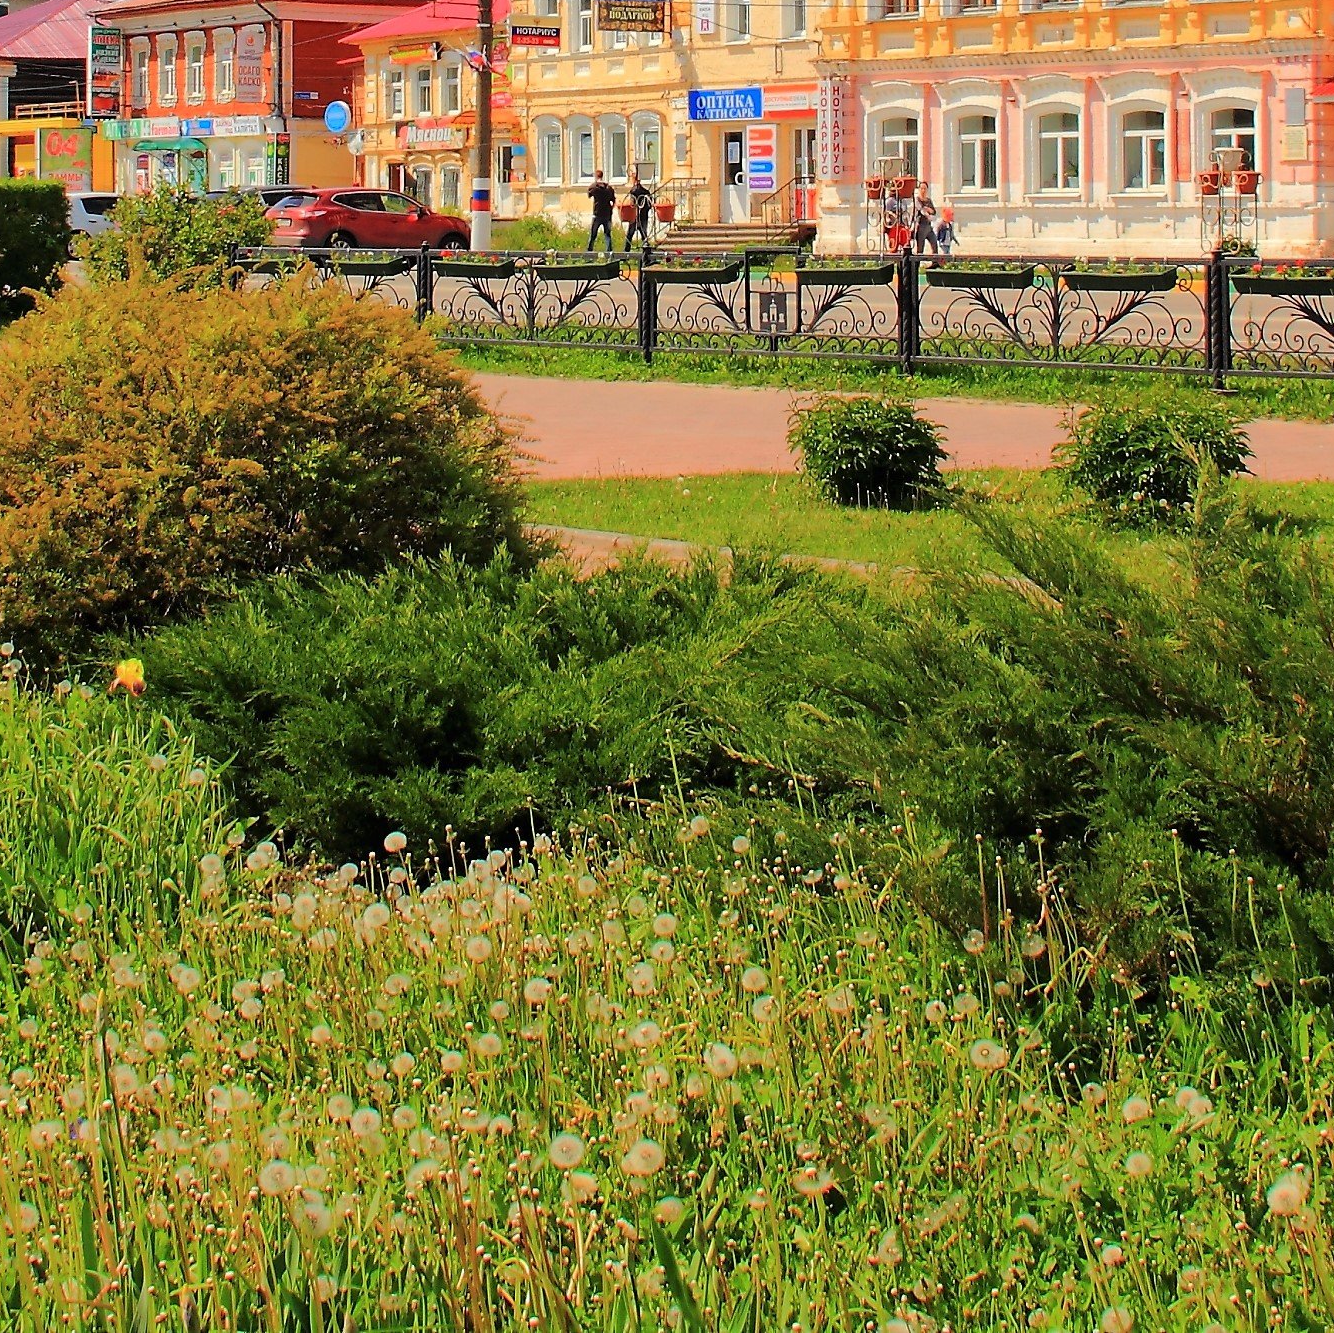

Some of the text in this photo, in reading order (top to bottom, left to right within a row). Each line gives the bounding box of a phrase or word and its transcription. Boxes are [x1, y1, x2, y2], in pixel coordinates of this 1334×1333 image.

[516, 27, 557, 36] НОТАРИУС
[239, 65, 260, 75] ОСАГО
[238, 76, 261, 86] КАСКО
[696, 93, 755, 110] ОПТИКА
[697, 108, 755, 120] КАТТИ САРК
[820, 86, 829, 175] НОТАРИУС
[832, 86, 841, 175] НОТАРИУС
